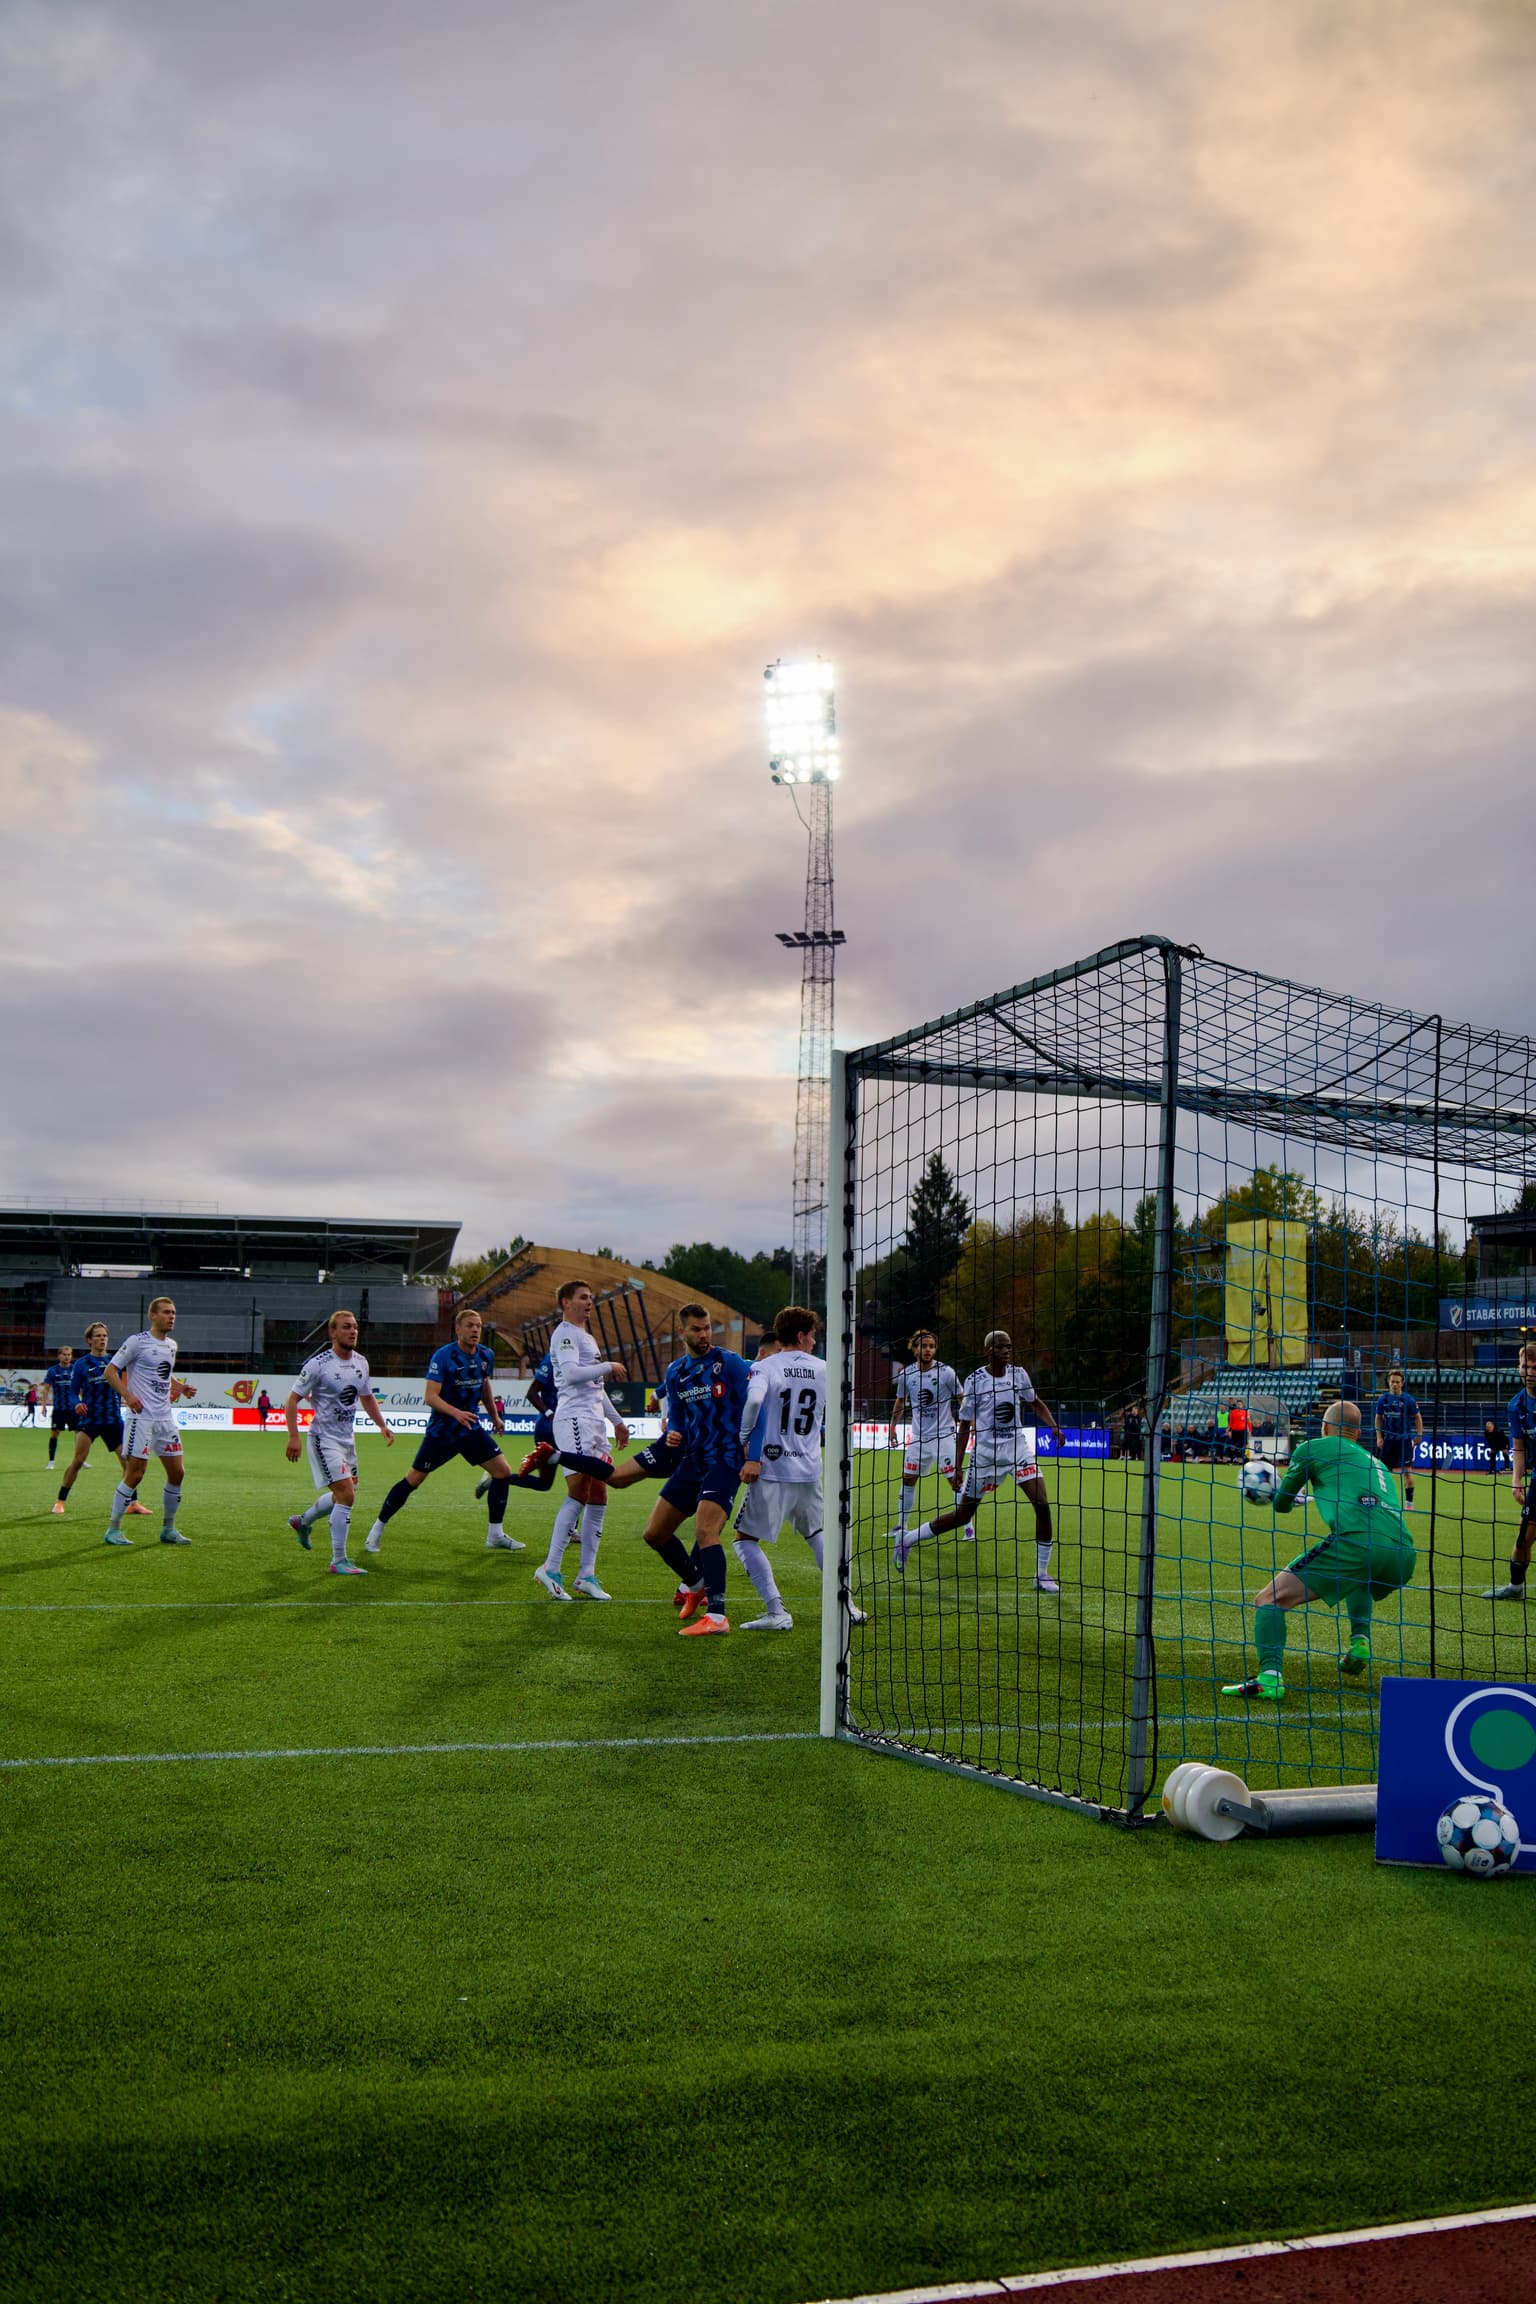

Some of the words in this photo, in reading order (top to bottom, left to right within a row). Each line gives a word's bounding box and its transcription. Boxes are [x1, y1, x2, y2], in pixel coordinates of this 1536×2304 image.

[1467, 1309, 1501, 1320] STABÆK
[784, 1368, 815, 1379] SKJELDAL
[391, 1394, 423, 1406] Color
[780, 1388, 817, 1436] 13
